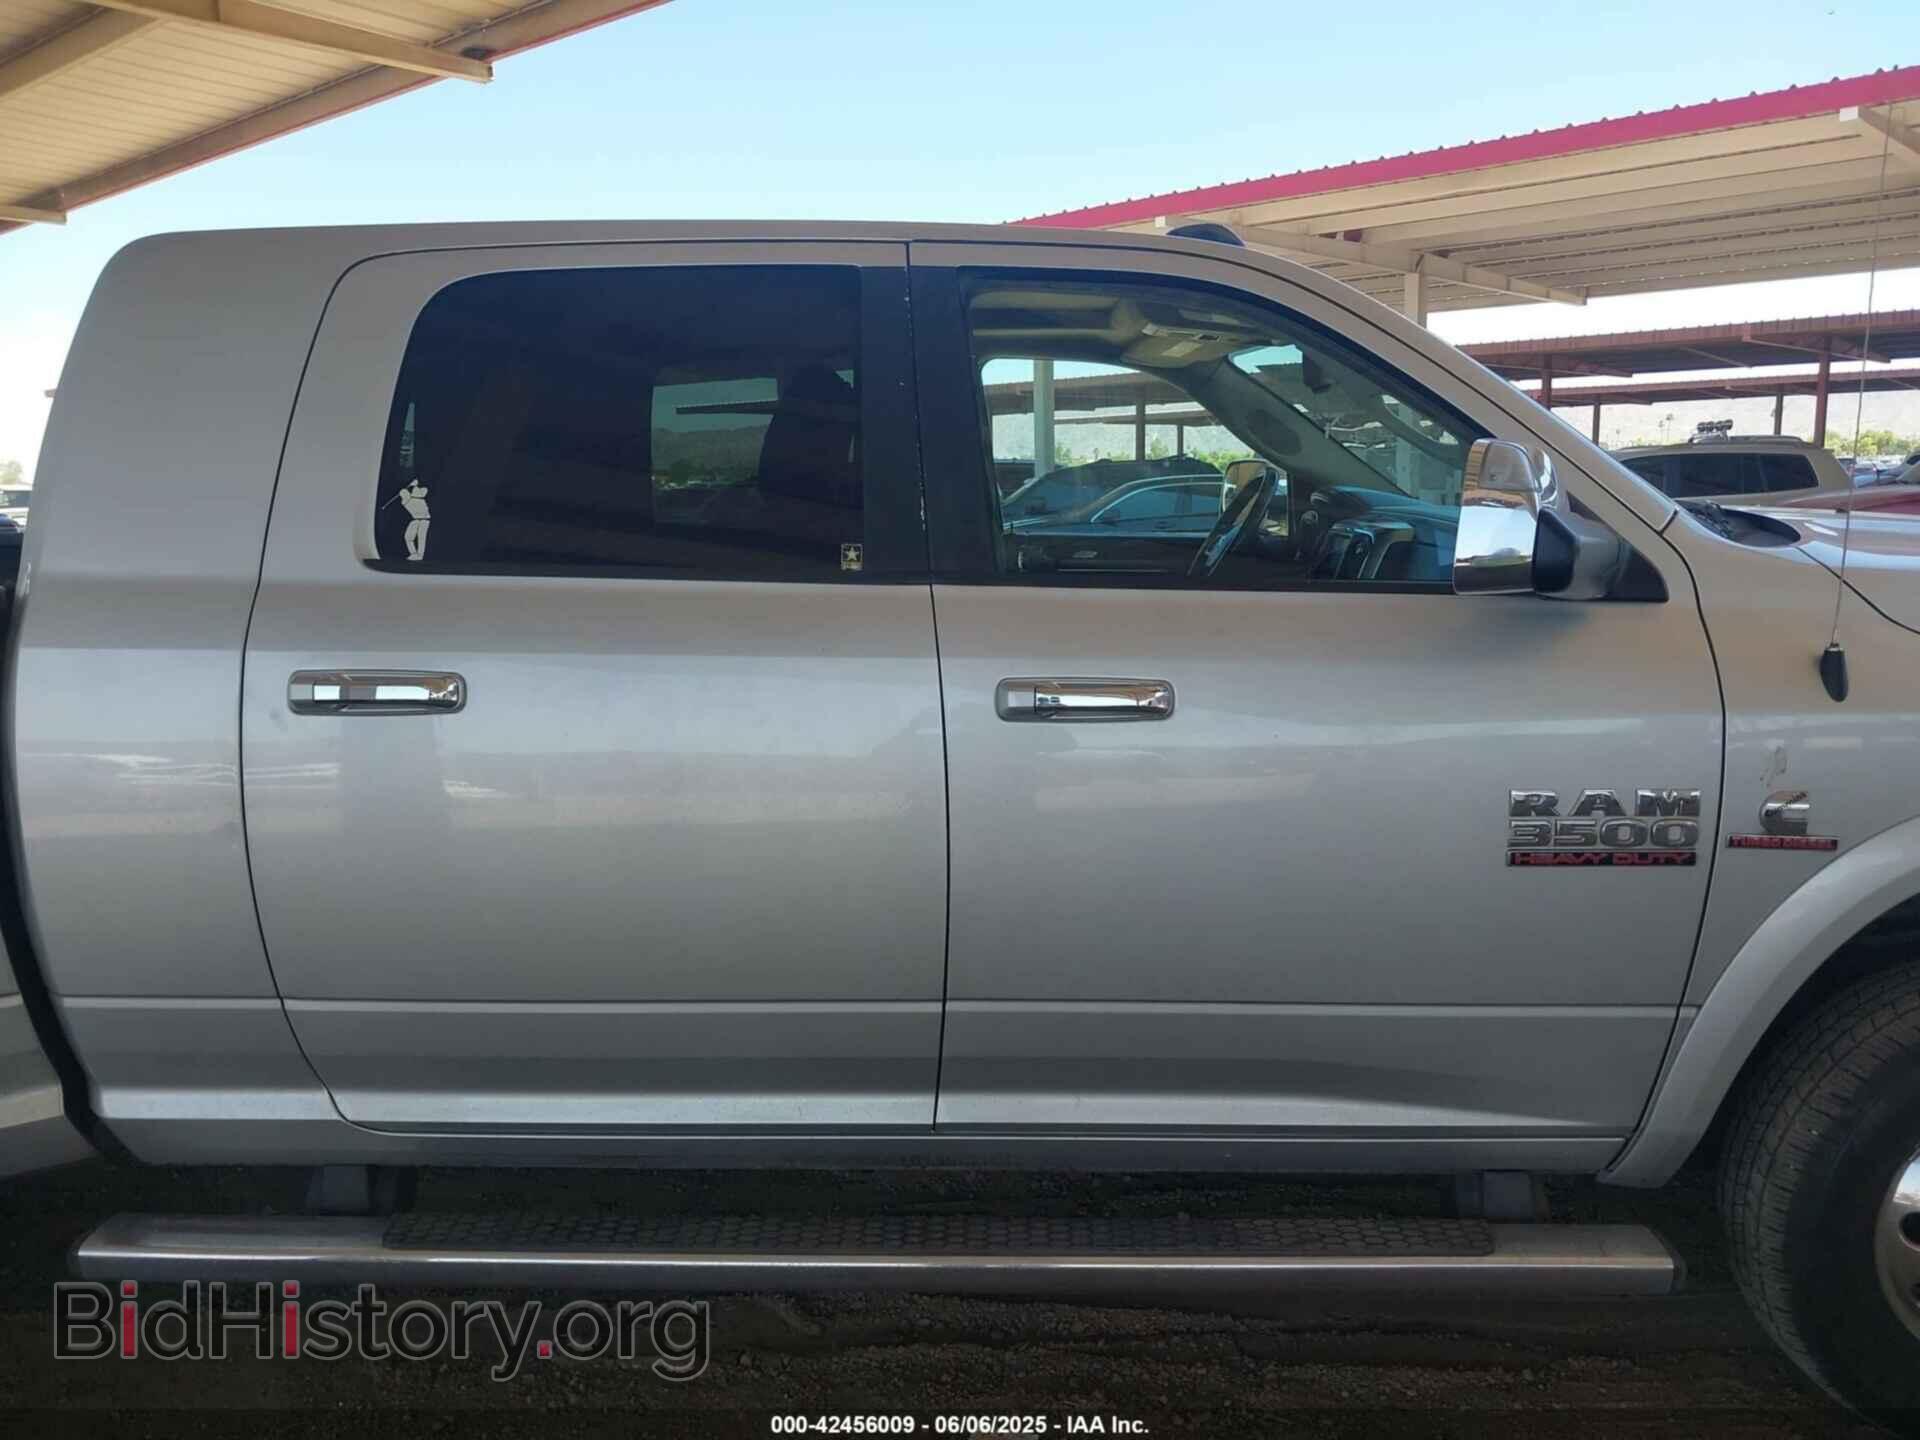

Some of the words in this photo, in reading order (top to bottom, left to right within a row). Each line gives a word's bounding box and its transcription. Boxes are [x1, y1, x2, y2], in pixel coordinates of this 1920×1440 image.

[1509, 788, 1701, 817] RAM
[1507, 818, 1699, 848] 3500
[1514, 852, 1607, 865] HEAVY
[1612, 852, 1692, 866] DUTY
